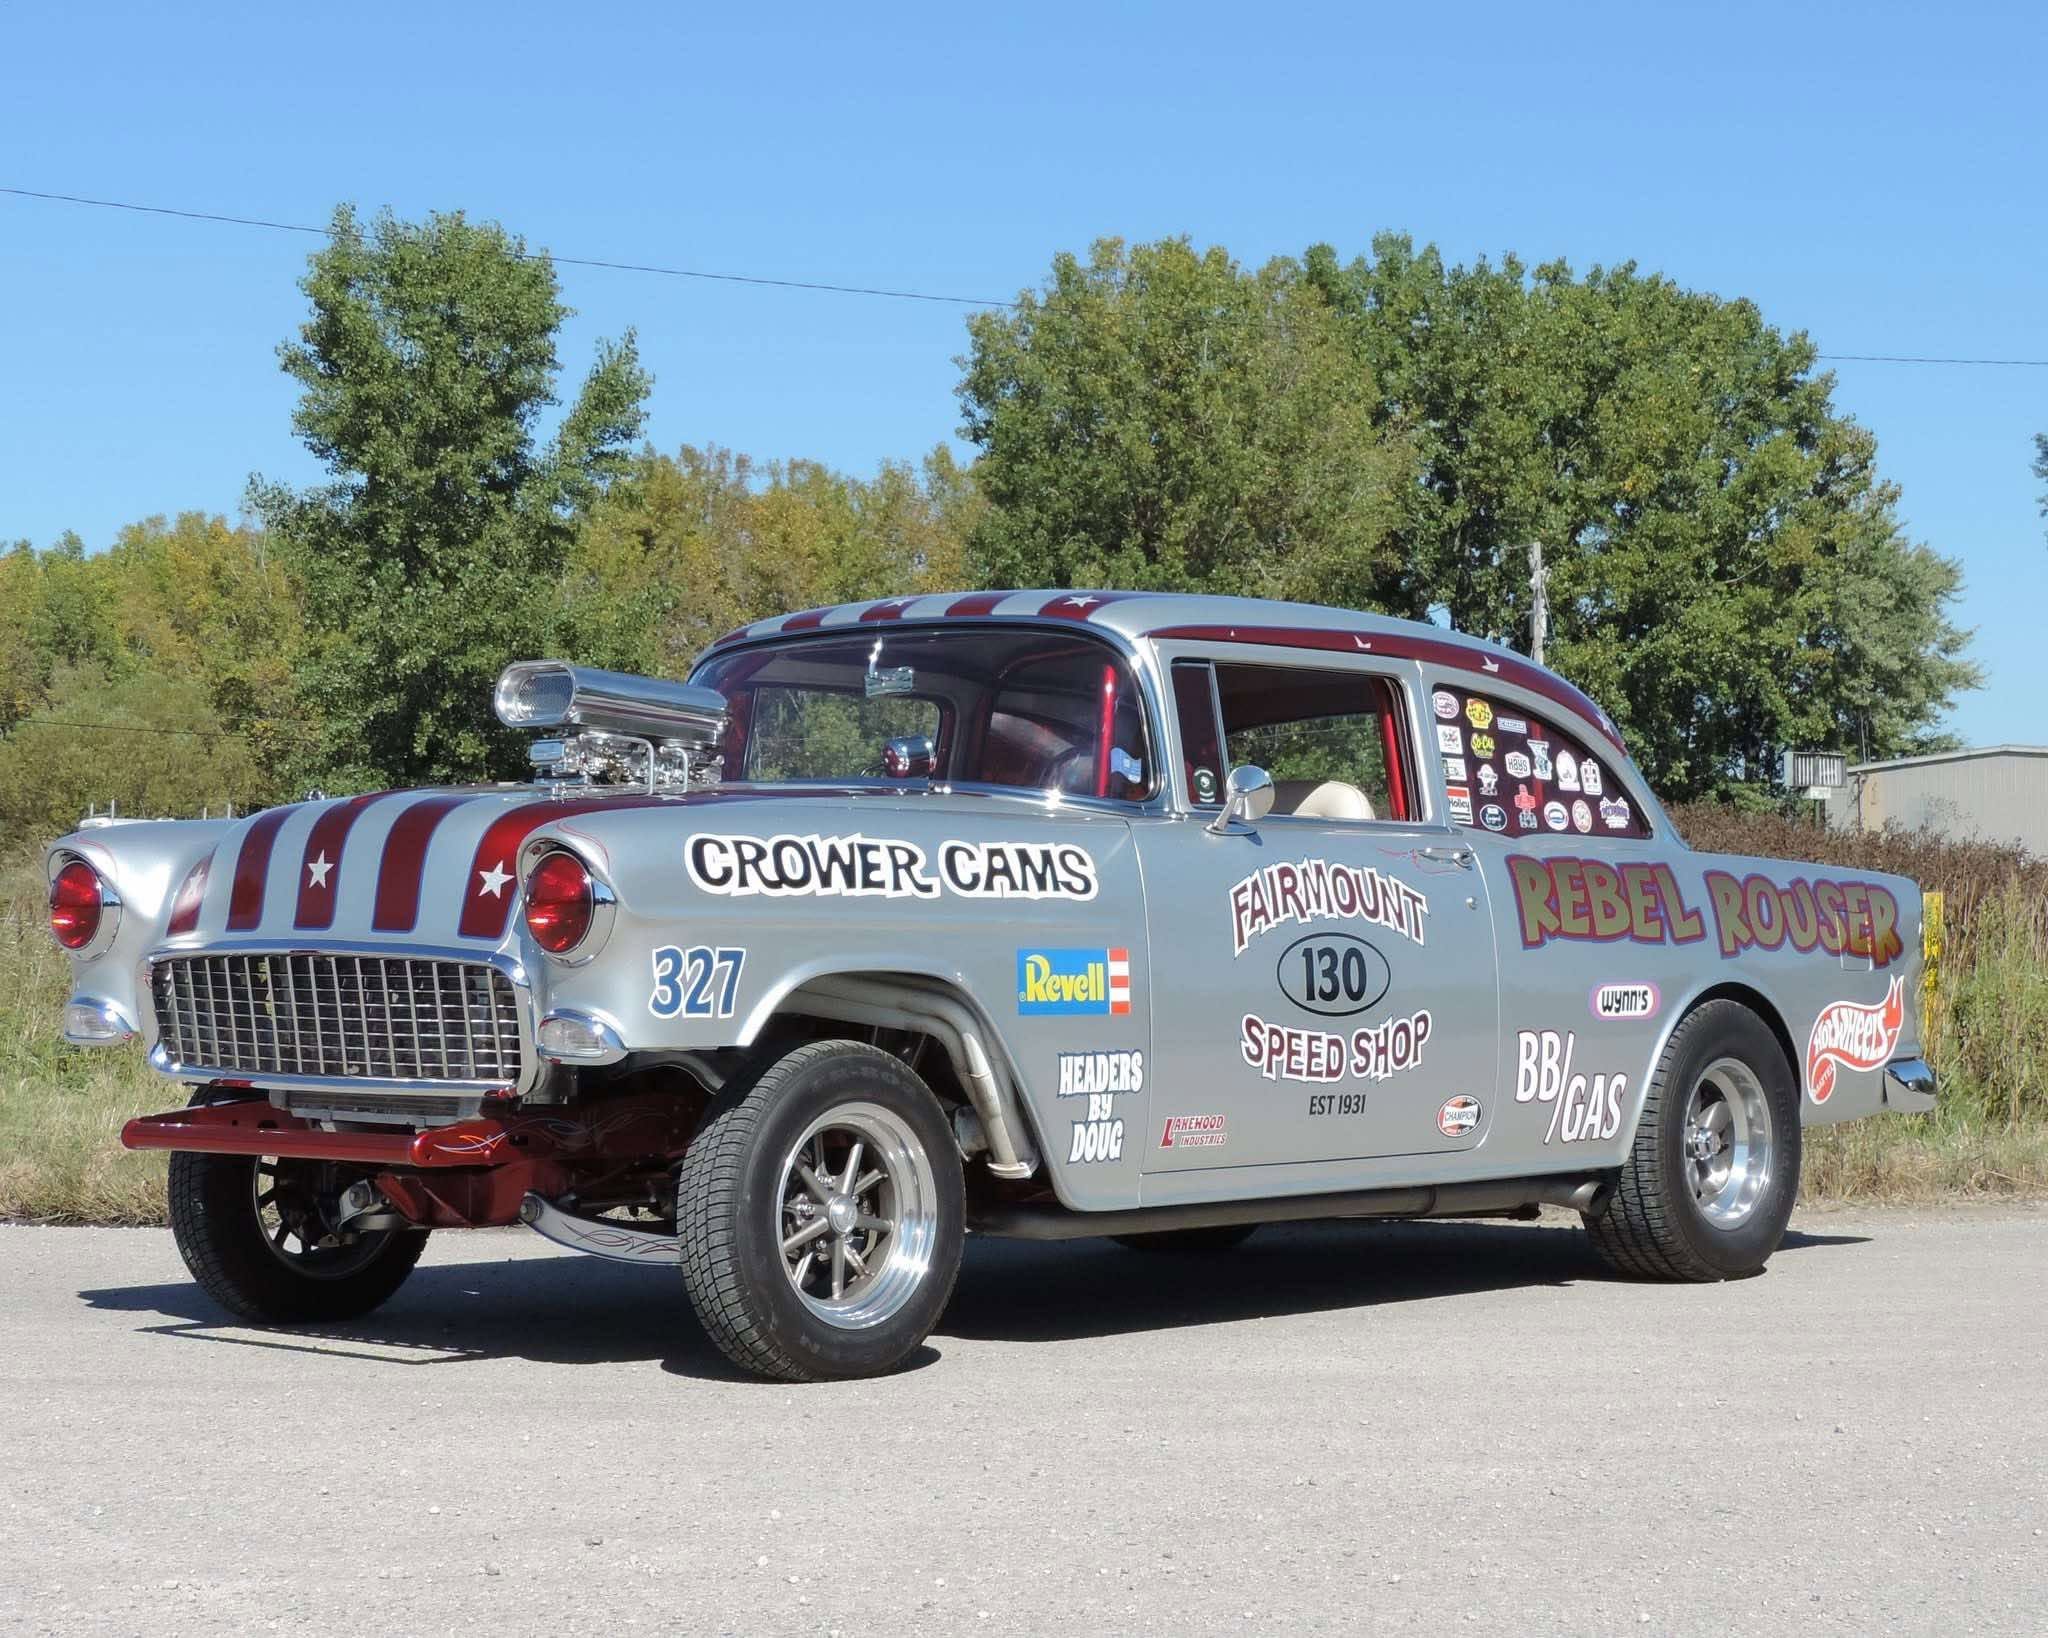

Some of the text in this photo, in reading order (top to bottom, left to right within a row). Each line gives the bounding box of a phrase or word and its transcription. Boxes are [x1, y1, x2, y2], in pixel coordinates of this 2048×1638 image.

[687, 835, 1096, 899] CROWER CAMS
[1230, 859, 1429, 955] FAIRMOUNT
[1506, 855, 1903, 968] REBEL ROUSER
[649, 946, 746, 1017] 327
[1025, 954, 1105, 1003] Revell
[1301, 946, 1368, 1002] 130
[1241, 1009, 1431, 1083] SPEED SHOP
[1057, 1052, 1143, 1097] HEADERS
[1088, 1091, 1113, 1121] BY
[1308, 1093, 1367, 1116] EST 1931
[1445, 1110, 1477, 1124] CHAMPION
[1067, 1120, 1123, 1162] DOUG
[1179, 1133, 1227, 1148] INDUSTRIES
